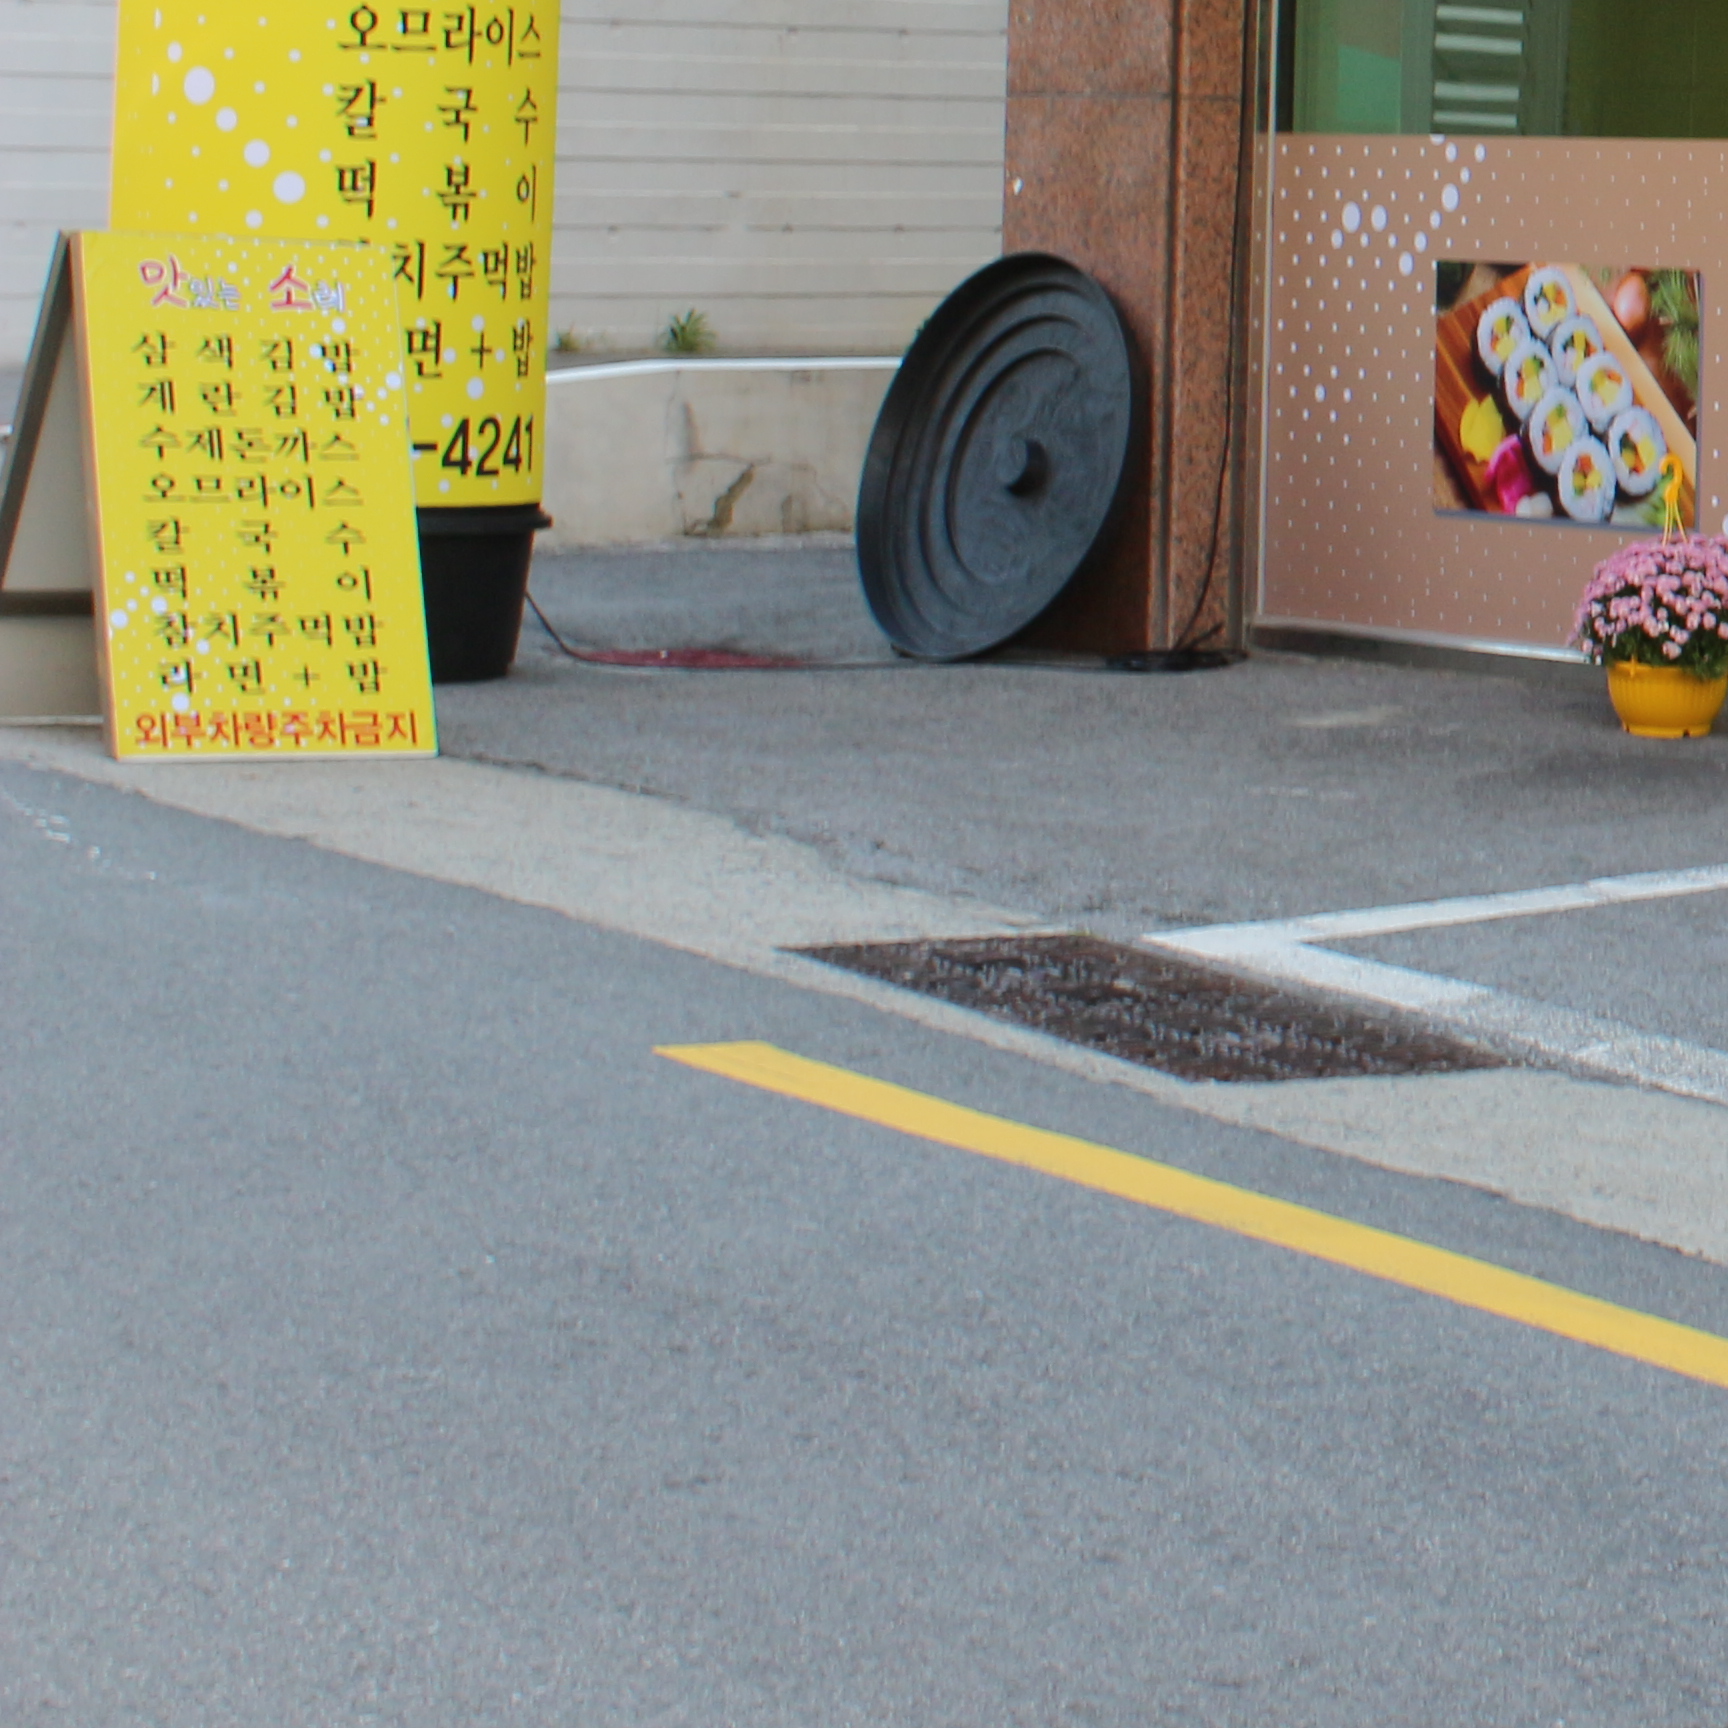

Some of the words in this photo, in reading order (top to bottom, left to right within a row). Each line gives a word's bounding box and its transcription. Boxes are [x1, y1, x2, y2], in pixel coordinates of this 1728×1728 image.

[337, 3, 541, 67] 오므라이스
[336, 79, 539, 147] 칼국수
[336, 158, 538, 223] 떡볶이
[138, 253, 242, 311] 맛있는
[267, 263, 347, 313] 소리
[390, 239, 536, 303] 치주먹밥
[139, 424, 361, 465] 수제돈까스
[407, 414, 535, 478] -4241
[142, 472, 365, 510] 오므라이스
[154, 611, 385, 649] 참치주먹밥
